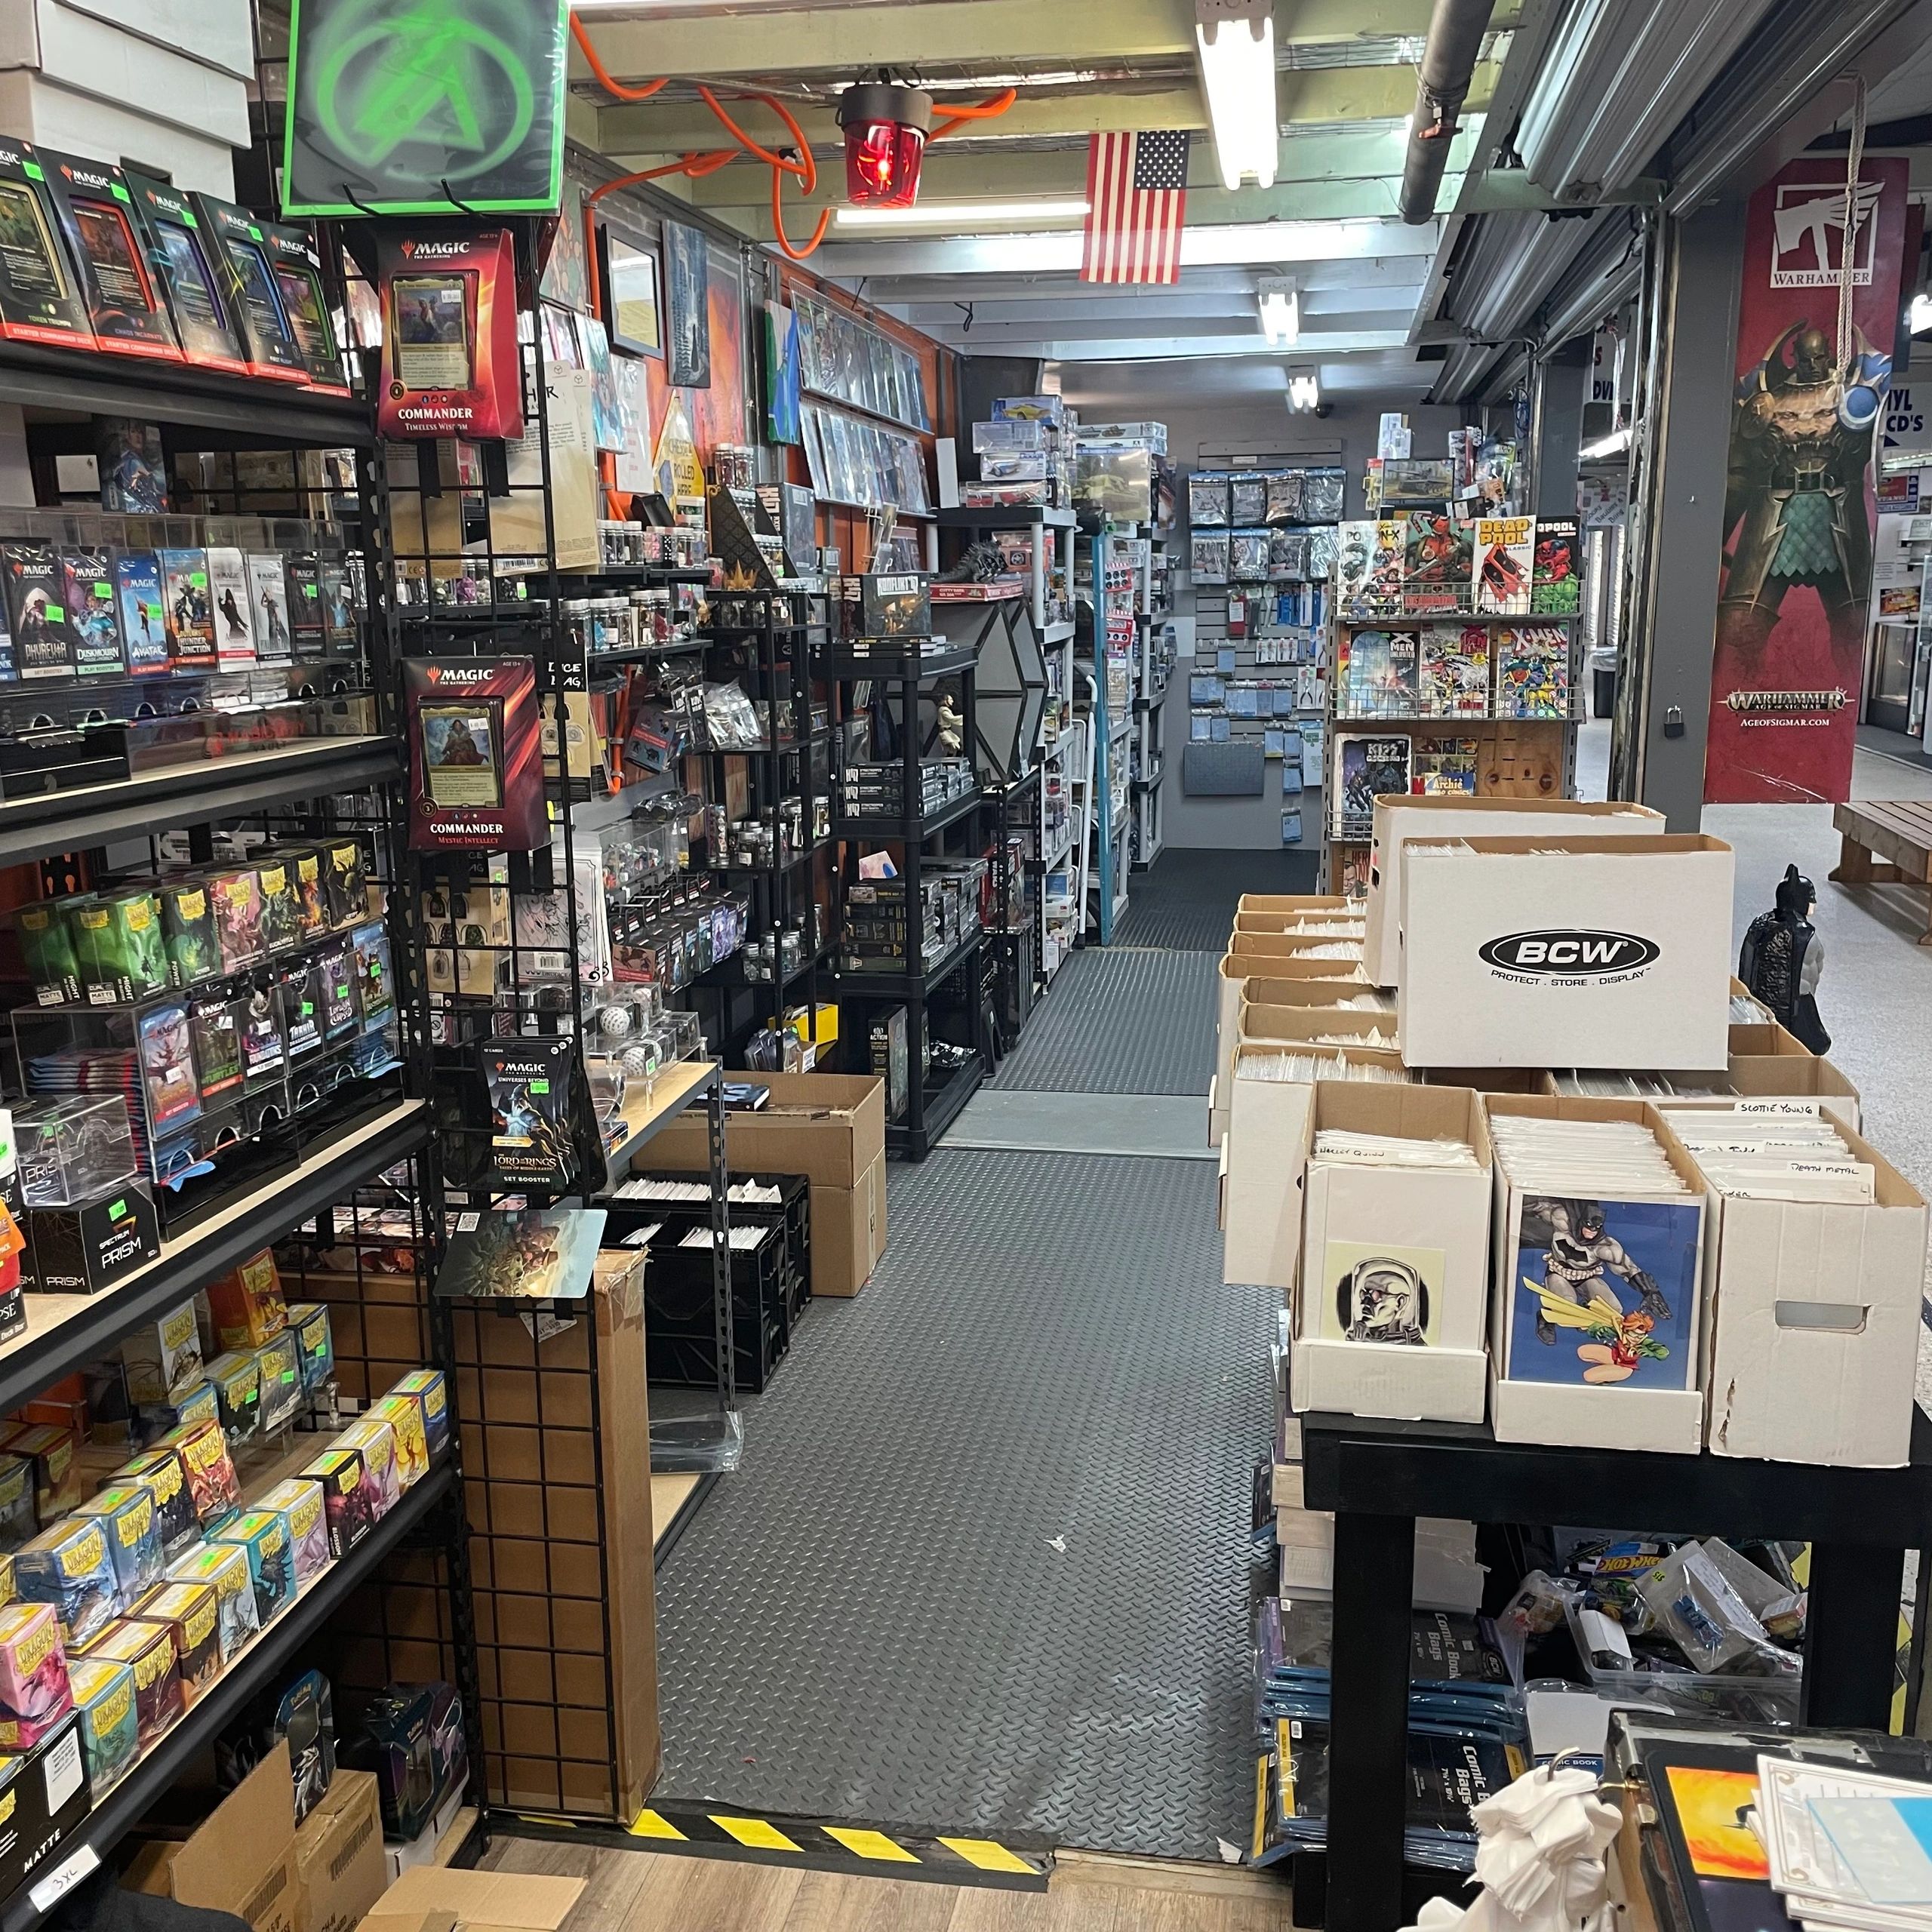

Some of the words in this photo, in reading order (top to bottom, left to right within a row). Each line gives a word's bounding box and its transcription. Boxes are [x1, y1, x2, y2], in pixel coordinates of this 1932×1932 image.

[0, 150, 20, 165] GIC
[73, 170, 110, 187] MAGIC
[156, 195, 181, 211] MAGIC
[227, 215, 249, 227] MAGIC
[279, 240, 306, 253] MAGIC
[414, 242, 469, 255] MAGIC
[1774, 272, 1869, 285] WARHAMER
[398, 408, 473, 420] COMMANDER
[405, 423, 438, 431] TIMELESS
[1887, 415, 1924, 432] CD'S
[673, 463, 694, 480] ROLLED
[1480, 519, 1530, 533] DEAD
[1480, 533, 1529, 545] POOL
[23, 565, 54, 574] MAGIC
[75, 568, 106, 577] MAGIC
[297, 569, 315, 578] MAGIC
[131, 579, 156, 587] MAGIC
[176, 635, 207, 646] THUNDER
[1392, 632, 1414, 642] X
[1511, 627, 1569, 651] X-MEN
[132, 645, 167, 658] AVATAR
[179, 645, 211, 655] JUNCTION
[1390, 641, 1414, 651] MEN
[77, 647, 119, 660] DUSKMOURN
[441, 669, 495, 681] MAGIC
[1728, 692, 1841, 709] WARHAMMER
[1367, 743, 1398, 755] KISS
[1433, 777, 1463, 789] Archie
[430, 823, 504, 834] COMMANDER
[326, 952, 344, 965] MAGIC
[1515, 941, 1624, 964] BCW
[171, 961, 180, 986] POWER
[288, 968, 309, 980] MAGIC
[1491, 969, 1541, 986] PROTECT
[1598, 969, 1644, 986] DISPLAY
[68, 975, 80, 999] MIGHT
[122, 976, 134, 1001] MIGHT
[204, 1001, 227, 1015] MAGIC
[289, 1020, 315, 1040] TARKIR
[506, 1063, 546, 1072] MAGIC
[1780, 1104, 1813, 1114] YOUNG
[494, 1155, 520, 1166] LORD
[525, 1157, 556, 1168] RINGS
[1791, 1163, 1821, 1173] DEATH
[1826, 1166, 1860, 1174] METAL
[26, 1164, 59, 1183] PRIS
[99, 1229, 130, 1250] SPECTRUM
[101, 1236, 142, 1269] PRISM
[46, 1277, 85, 1286] PRISM
[188, 1435, 220, 1463] DRAGON
[291, 1495, 321, 1526] DRAGON
[120, 1509, 152, 1534] DRAGON
[332, 1527, 341, 1555] BLOSSOM
[65, 1536, 102, 1570] DRAGON
[19, 1626, 54, 1663] DRAGON
[1427, 1632, 1443, 1661] Bags
[1435, 1613, 1455, 1647] Comic
[1447, 1651, 1462, 1679] Book
[1487, 1656, 1502, 1675] BCW
[96, 1693, 130, 1728] DRAGON
[1463, 1746, 1487, 1789] Comic
[1455, 1767, 1472, 1805] Bags
[24, 1829, 61, 1873] MATTE
[53, 1869, 78, 1890] 3XL
